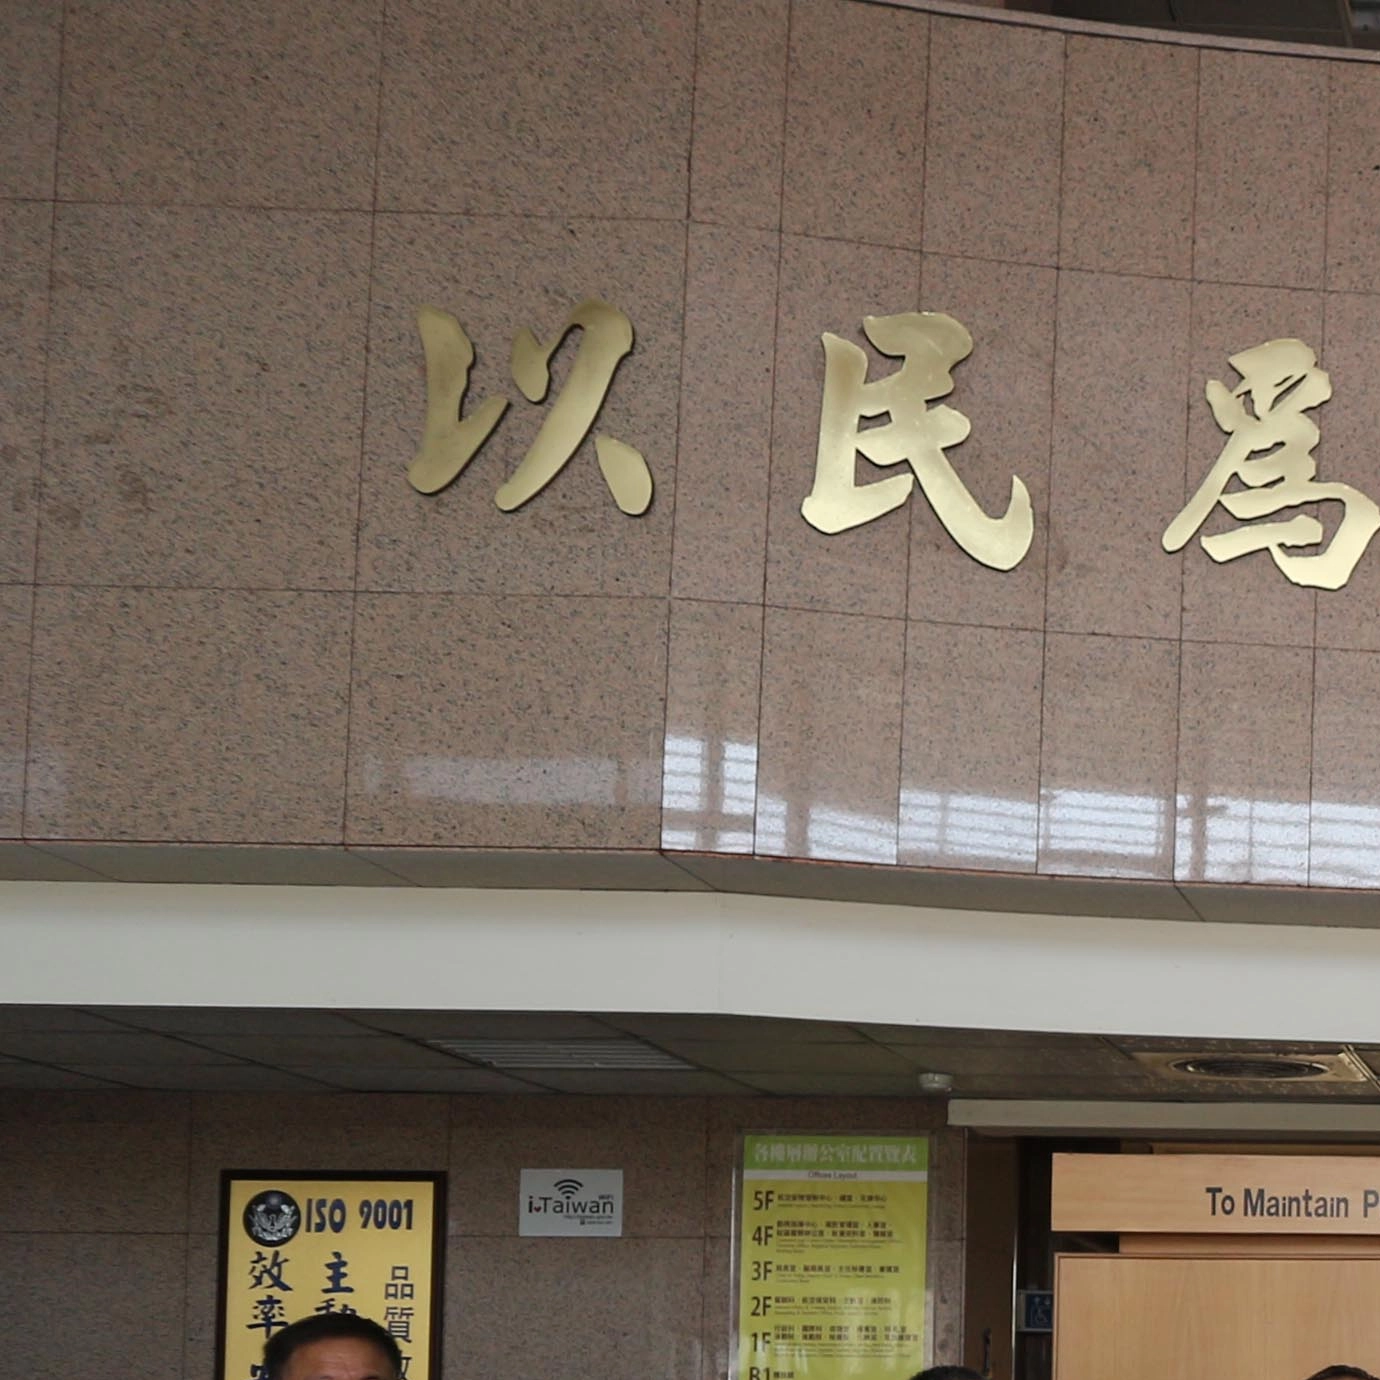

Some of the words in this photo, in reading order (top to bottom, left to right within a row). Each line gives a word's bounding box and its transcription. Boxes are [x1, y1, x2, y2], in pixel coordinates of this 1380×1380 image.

[753, 1190, 774, 1211] 5F
[1206, 1187, 1235, 1215] To
[1243, 1187, 1350, 1219] Maintain
[305, 1198, 346, 1233] ISO
[360, 1199, 413, 1230] 9001
[752, 1226, 773, 1246] 4F
[751, 1261, 773, 1281] 3F
[751, 1296, 772, 1316] 2F
[751, 1332, 771, 1352] 1F
